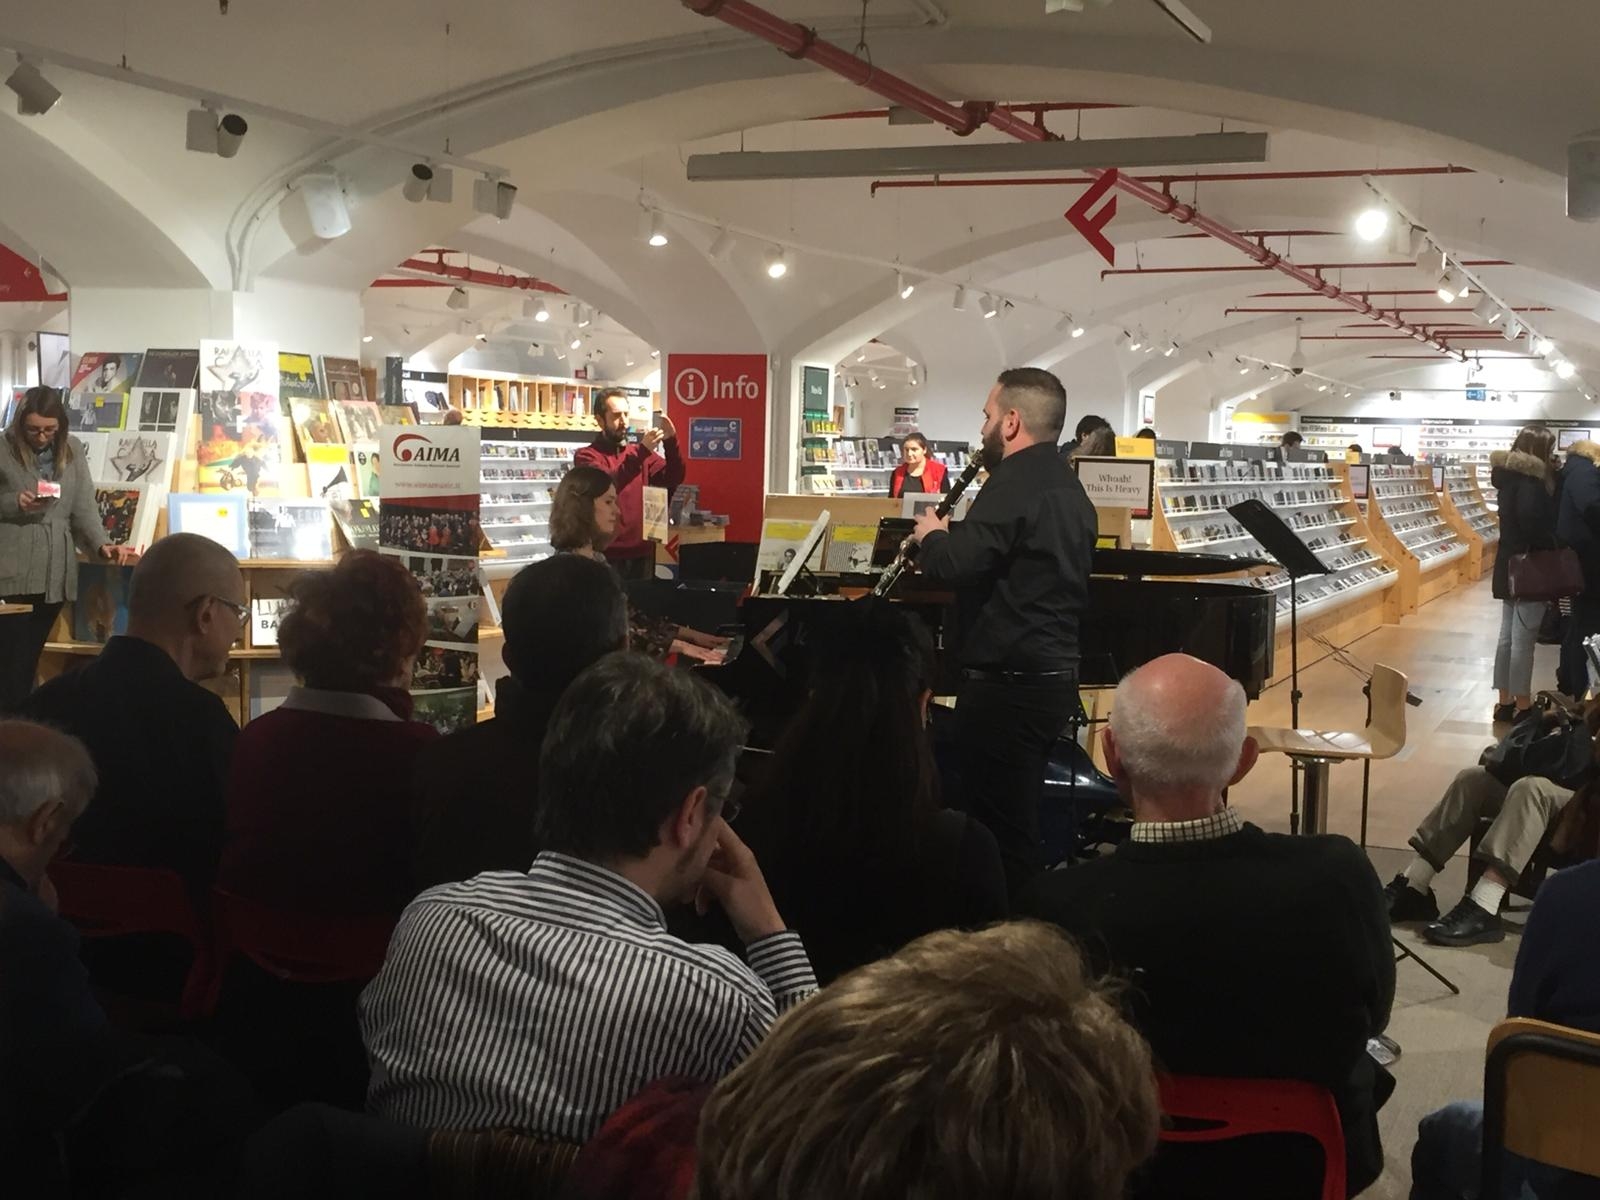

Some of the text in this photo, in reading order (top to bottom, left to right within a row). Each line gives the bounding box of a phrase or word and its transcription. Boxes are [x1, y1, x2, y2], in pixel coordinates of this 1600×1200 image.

[713, 375, 759, 399] Info
[413, 446, 461, 462] AIMA
[1098, 474, 1132, 483] Whoah!
[1086, 484, 1142, 496] This Is Heavy
